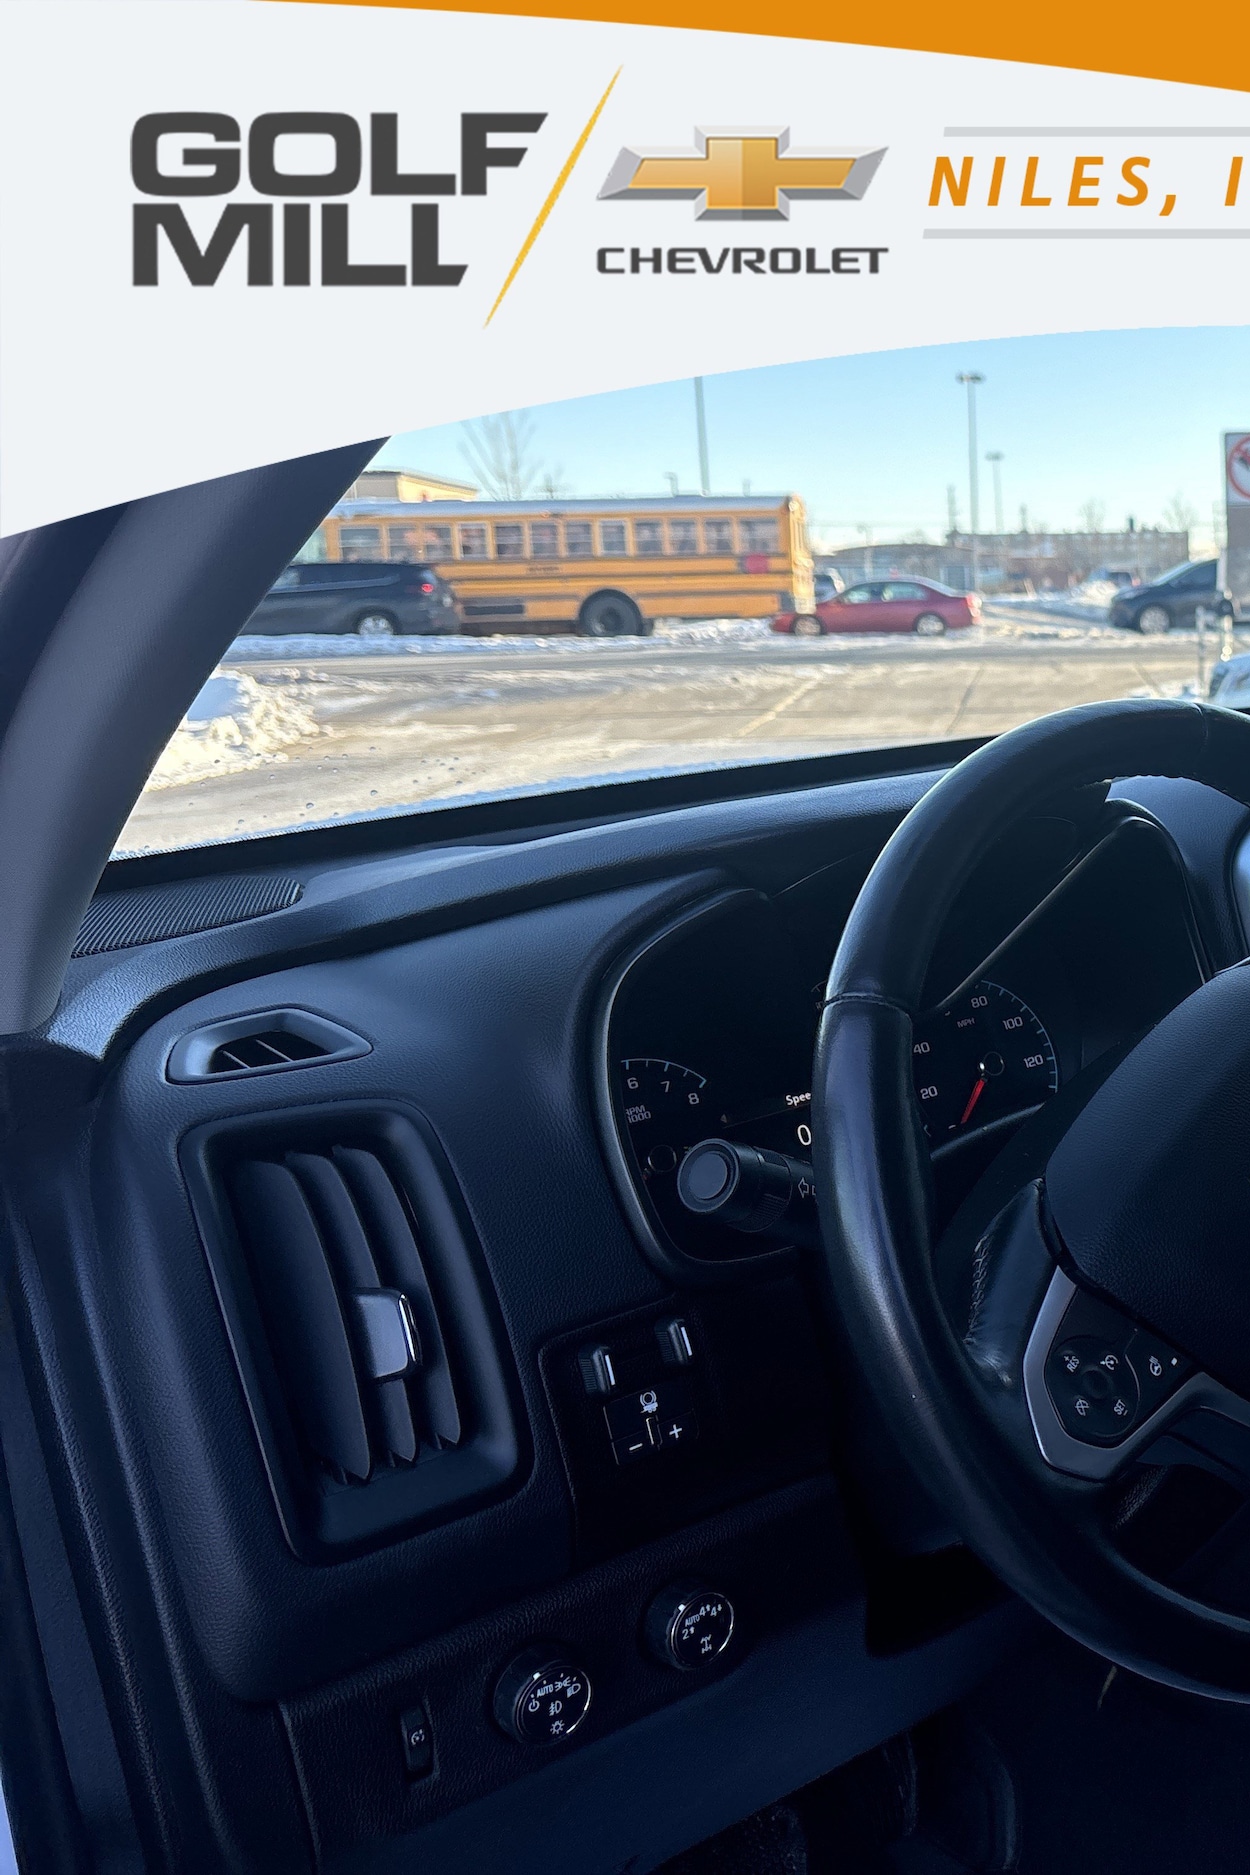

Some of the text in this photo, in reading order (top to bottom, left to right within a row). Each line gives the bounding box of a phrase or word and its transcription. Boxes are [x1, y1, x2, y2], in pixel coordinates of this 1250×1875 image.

[971, 996, 988, 1009] 80
[957, 1017, 976, 1029] MPH
[1003, 1016, 1023, 1030] 100
[913, 1042, 930, 1054] 40
[1024, 1054, 1044, 1069] 120
[627, 1077, 700, 1105] 6 7 8
[920, 1086, 938, 1100] 20
[785, 1092, 812, 1107] Spee
